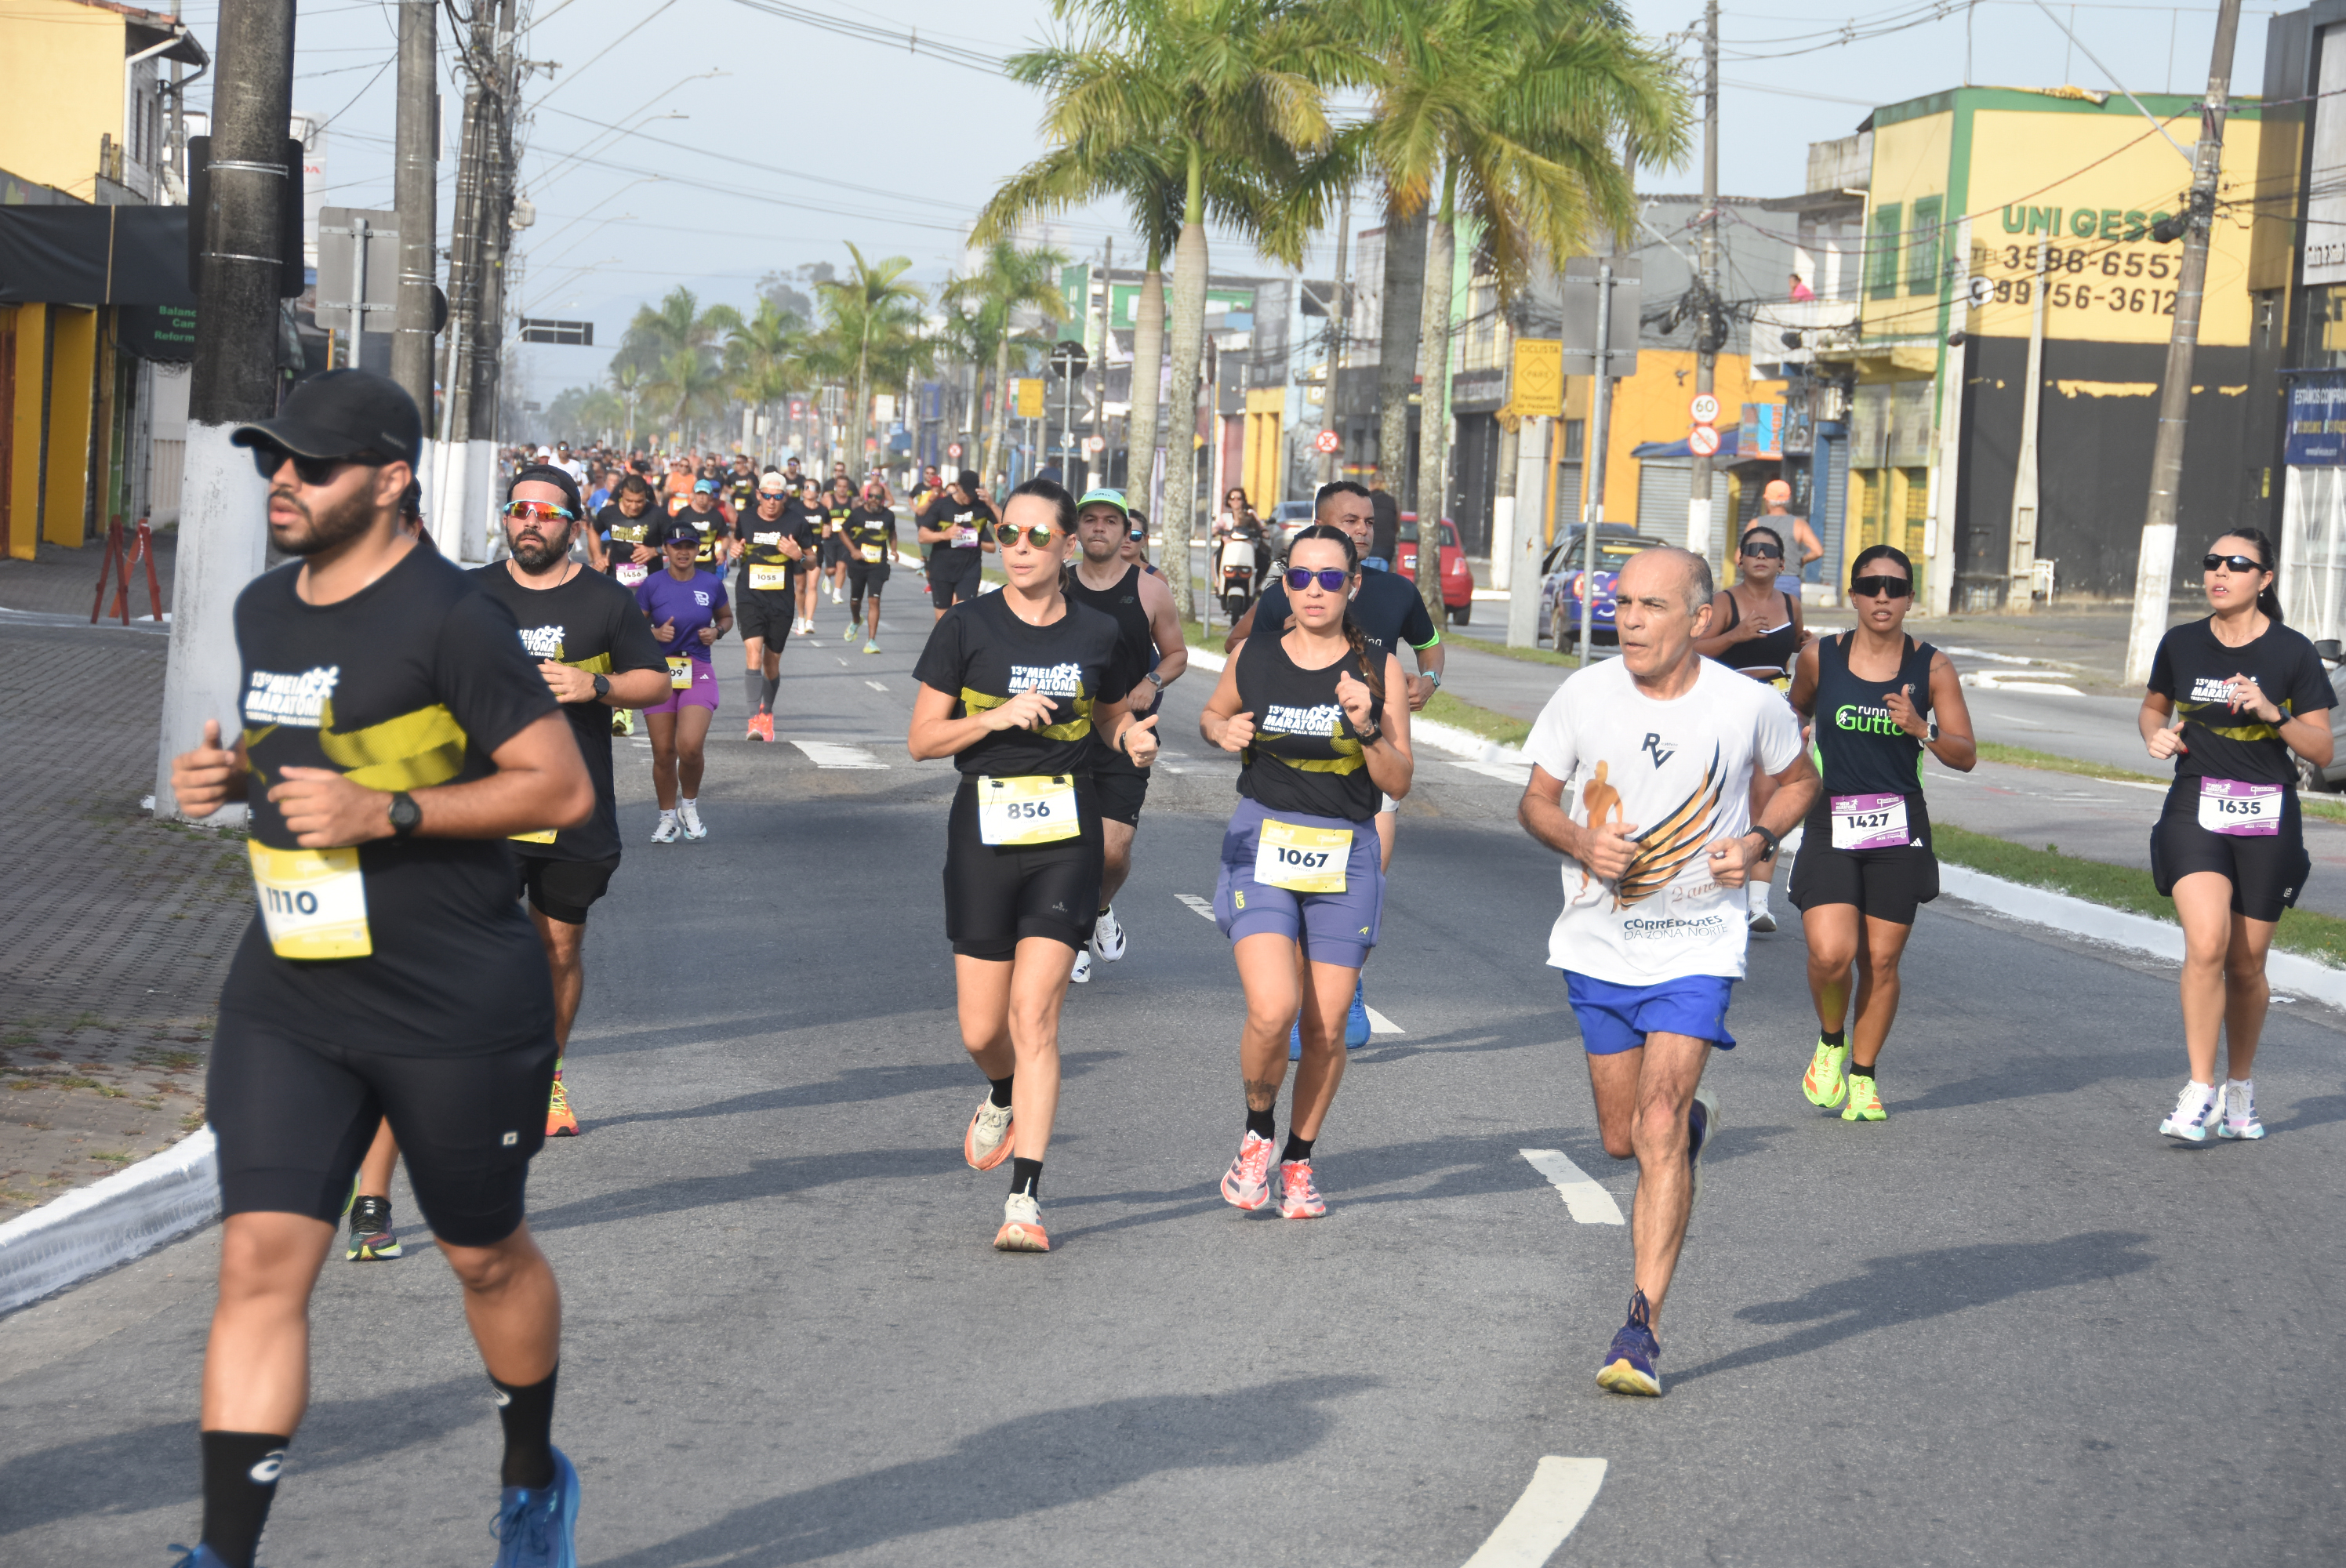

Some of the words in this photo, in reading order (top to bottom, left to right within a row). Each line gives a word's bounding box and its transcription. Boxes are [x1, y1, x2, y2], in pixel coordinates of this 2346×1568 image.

[2003, 204, 2061, 235] UNI
[2070, 209, 2186, 243] GESS
[1519, 344, 1559, 354] CICLISTA
[1696, 400, 1715, 412] 60
[1026, 667, 1058, 679] MEIA
[1008, 677, 1077, 691] MARATONA
[246, 690, 323, 716] MARATONA
[1282, 707, 1313, 720] MEIA
[1836, 705, 1905, 735] Gutto
[1263, 715, 1332, 731] MARATONA
[1008, 801, 1051, 819] 856
[2218, 799, 2261, 815] 1635
[1847, 813, 1889, 829] 1427
[1278, 847, 1329, 868] 1067
[1671, 886, 1683, 903] 2
[1687, 881, 1721, 898] ano
[266, 886, 318, 916] 1110
[1624, 915, 1723, 931] CORREDORES
[1624, 930, 1643, 941] DA
[1646, 927, 1683, 940] ZONA
[1687, 924, 1728, 937] NORTE
